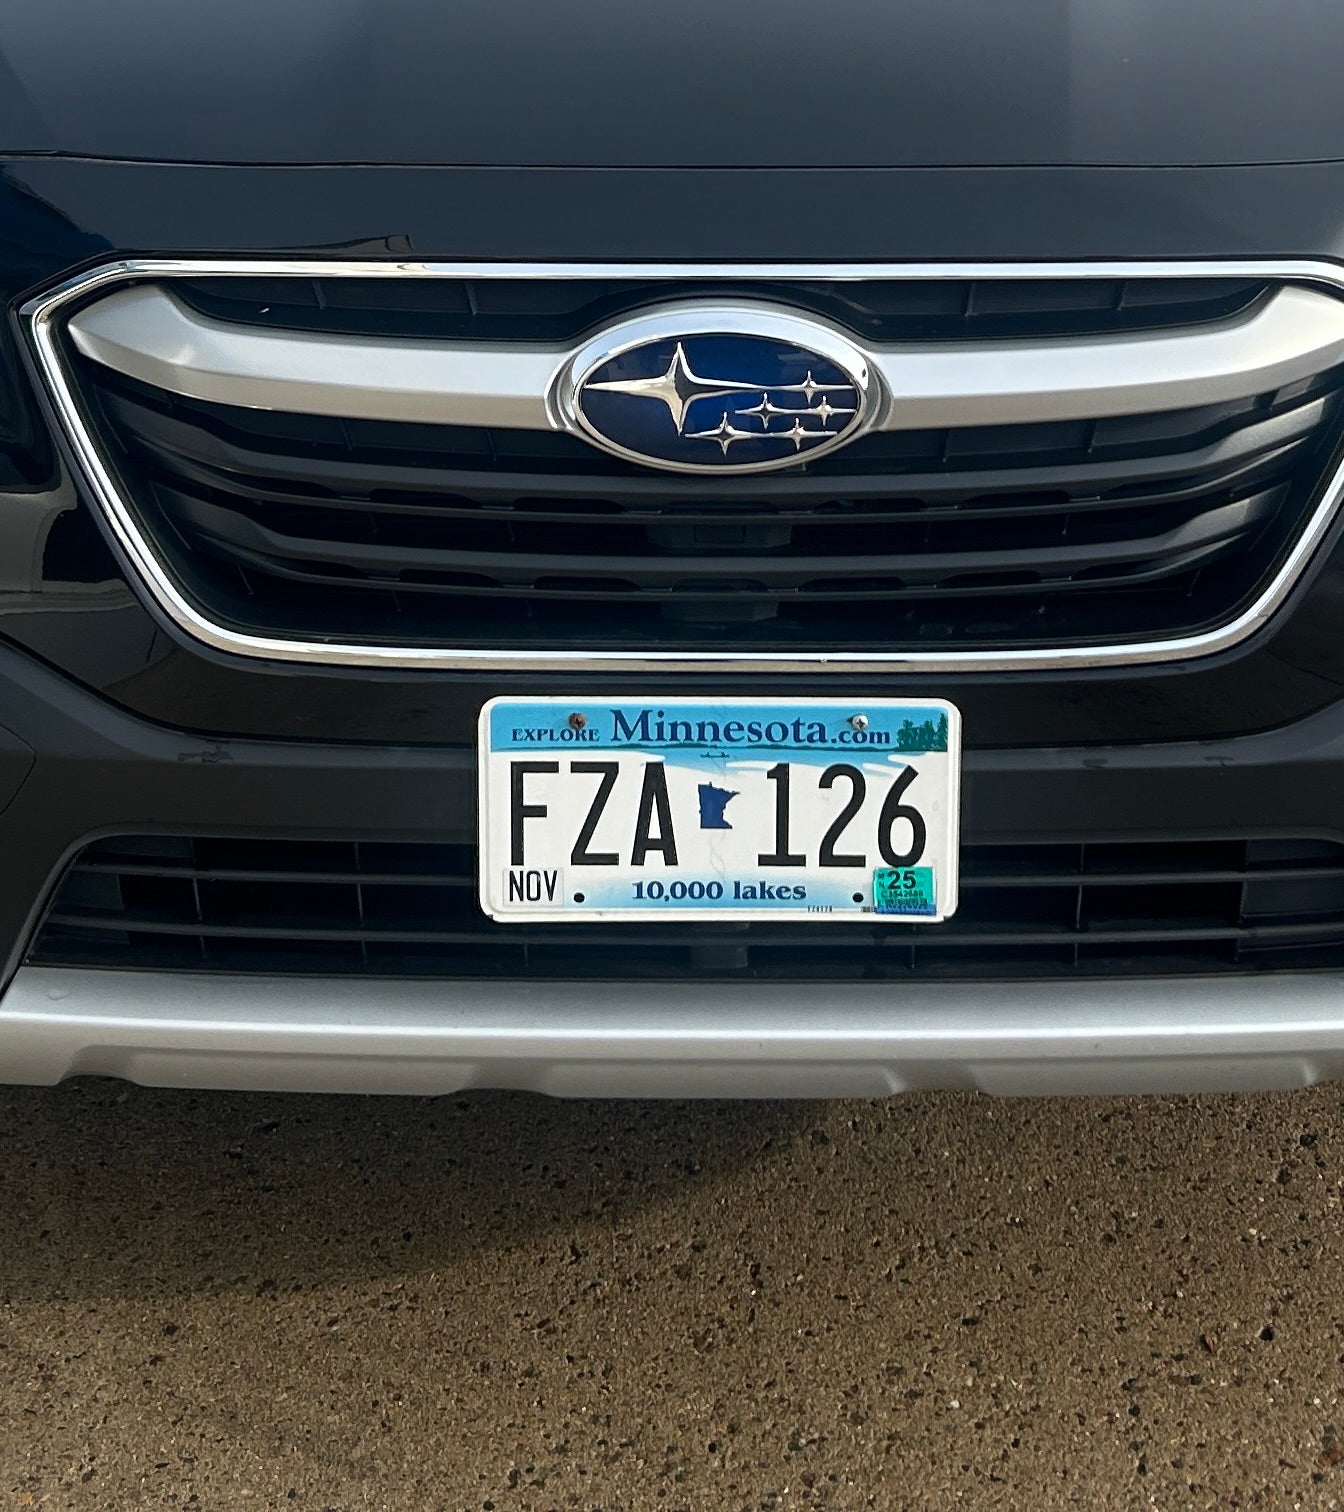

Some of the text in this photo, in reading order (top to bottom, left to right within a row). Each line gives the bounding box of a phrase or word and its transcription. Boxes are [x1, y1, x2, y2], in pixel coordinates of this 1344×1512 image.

[511, 727, 600, 743] EXPLORE
[509, 760, 927, 868] FZA 126
[508, 869, 558, 903] NOV
[632, 880, 807, 902] 10,000 lakes
[887, 870, 917, 890] 25
